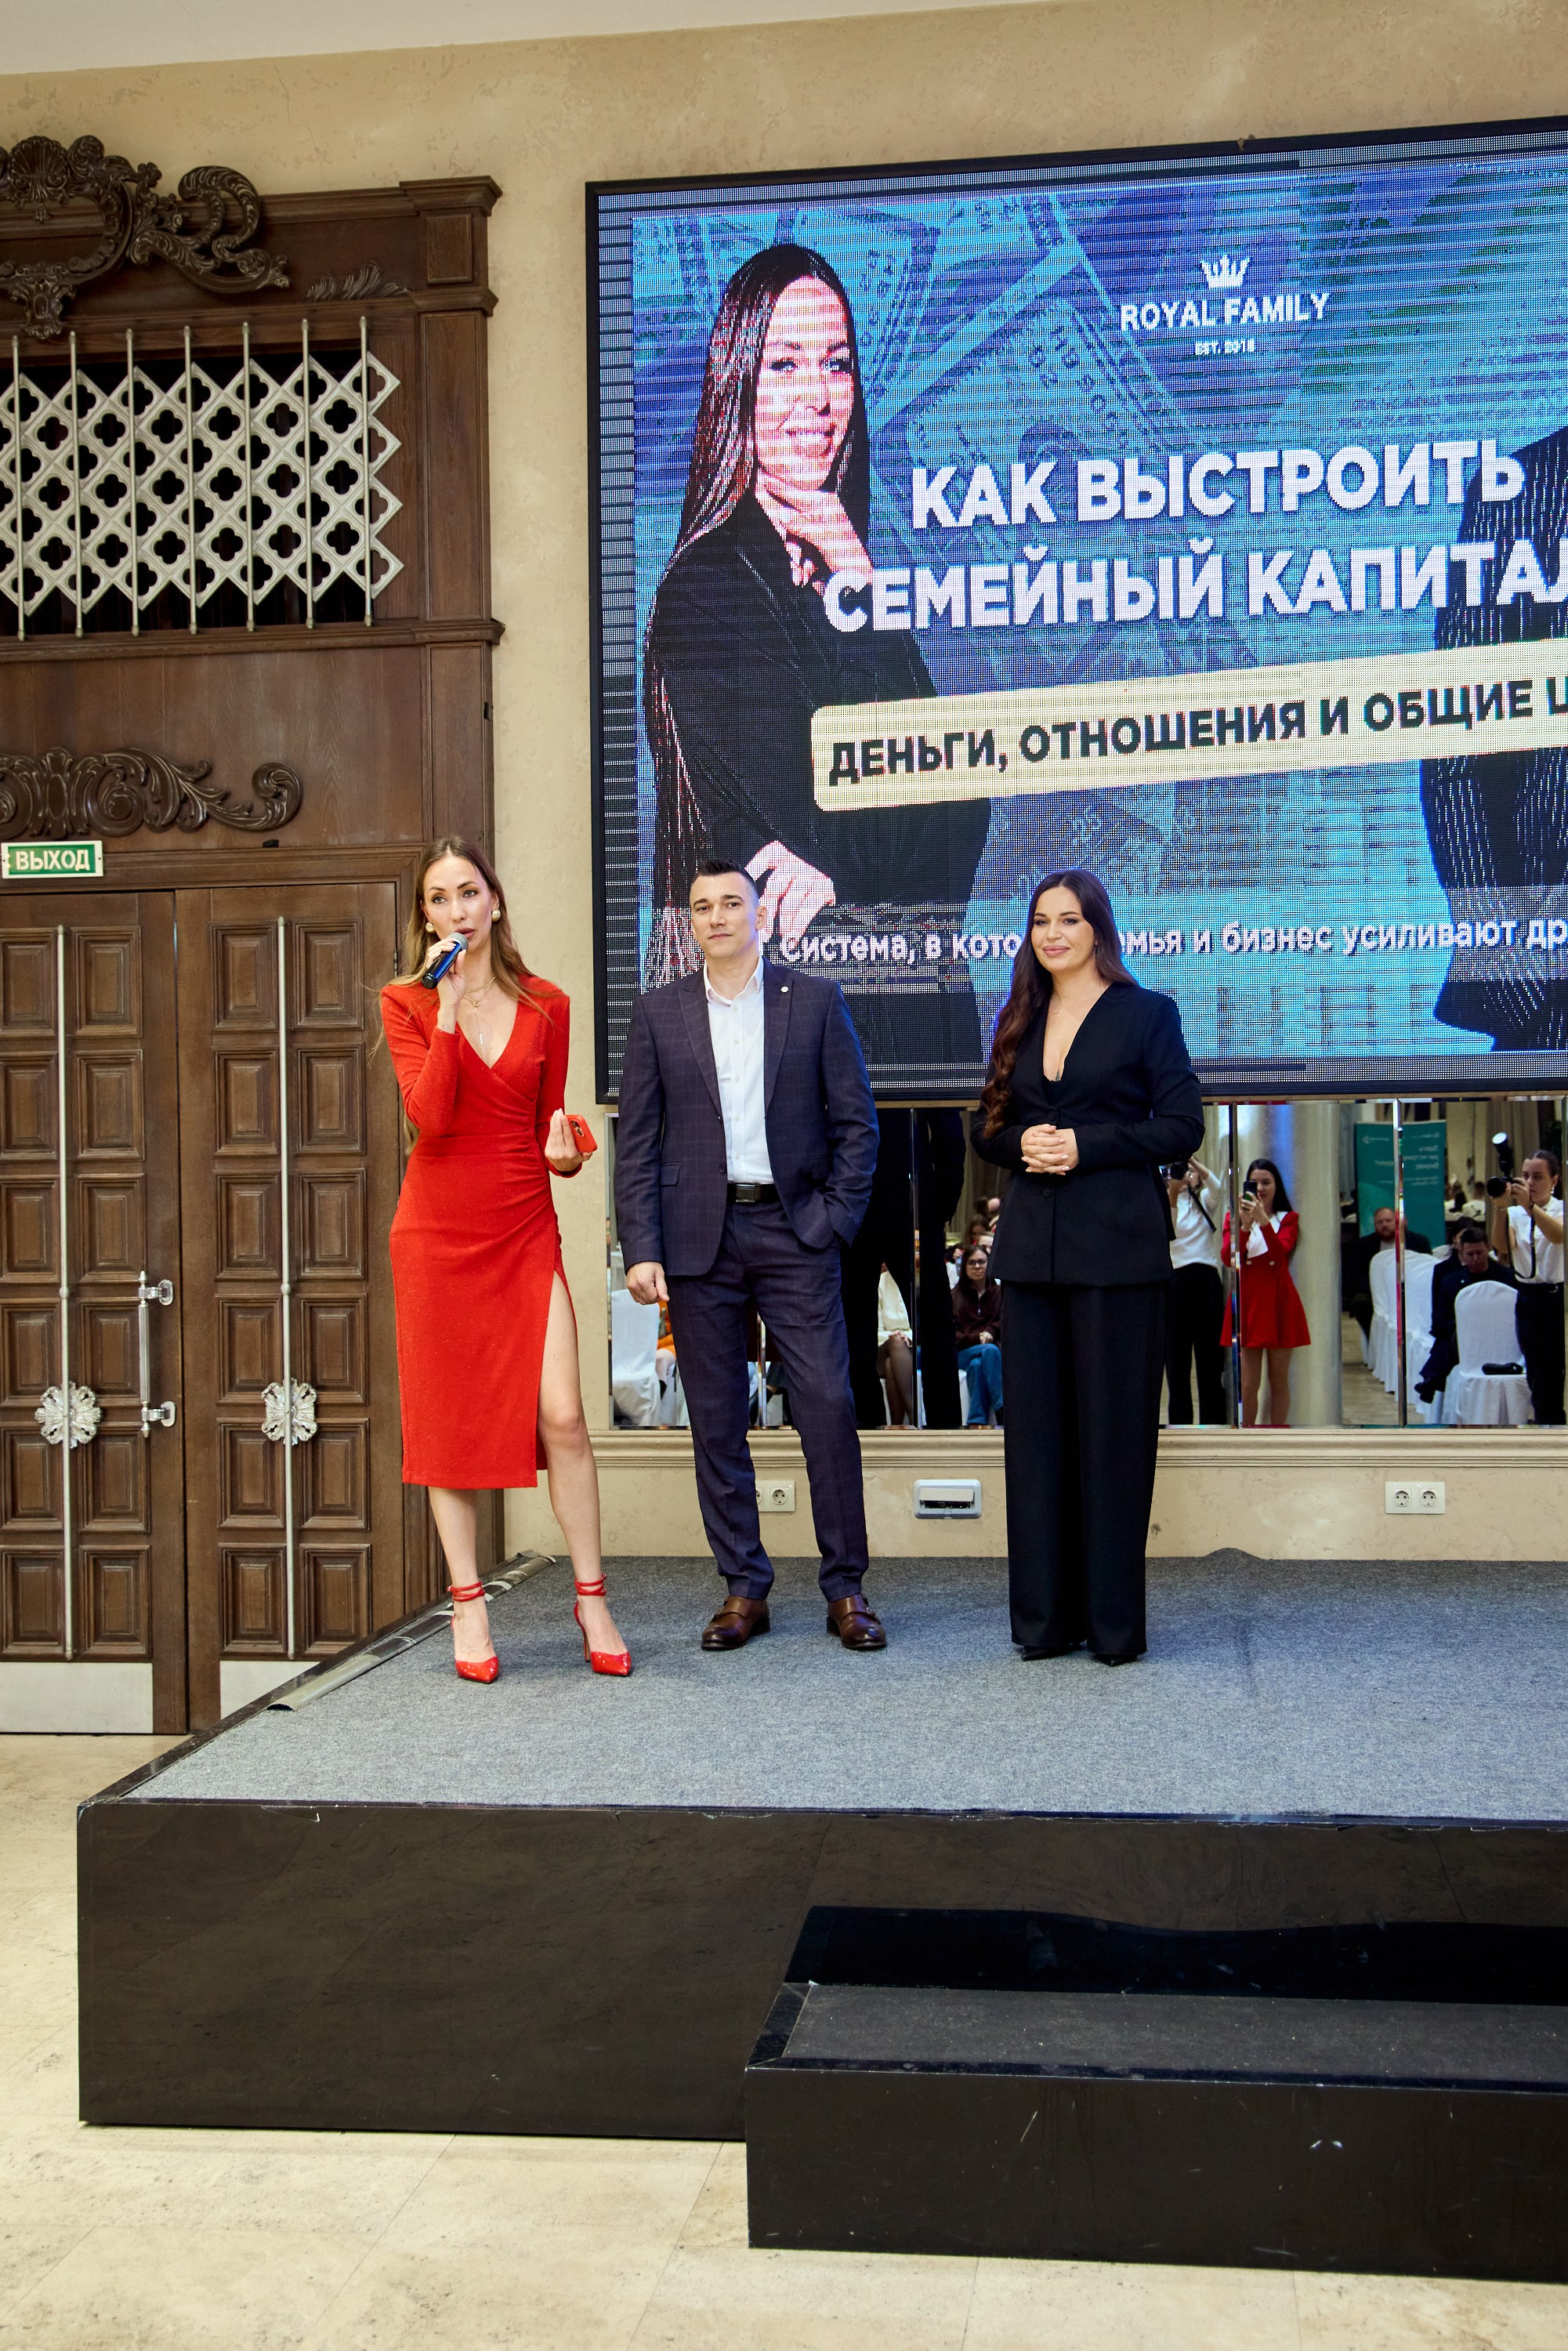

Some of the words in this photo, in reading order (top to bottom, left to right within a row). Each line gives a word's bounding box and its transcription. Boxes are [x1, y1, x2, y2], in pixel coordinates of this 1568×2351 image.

[1121, 299, 1215, 331] ROYAL
[1224, 293, 1330, 325] FAMILY
[912, 460, 1057, 529] КАК
[1077, 439, 1526, 522] ВЫСТРОИТЬ
[823, 537, 1225, 632] СЕМЕЙНЫЙ
[828, 729, 1009, 787] ДЕНЬГИ,
[1019, 700, 1306, 763] ОТНОШЕНИЯ
[1320, 696, 1349, 735] И
[1363, 679, 1534, 732] ОБЩИЕ
[16, 849, 90, 871] ВЫХОД
[925, 933, 942, 960] в
[952, 932, 1023, 959] кото
[1120, 929, 1181, 955] мья
[1193, 929, 1211, 953] и
[1222, 921, 1333, 953] бизнес
[1342, 919, 1519, 956] усиливают
